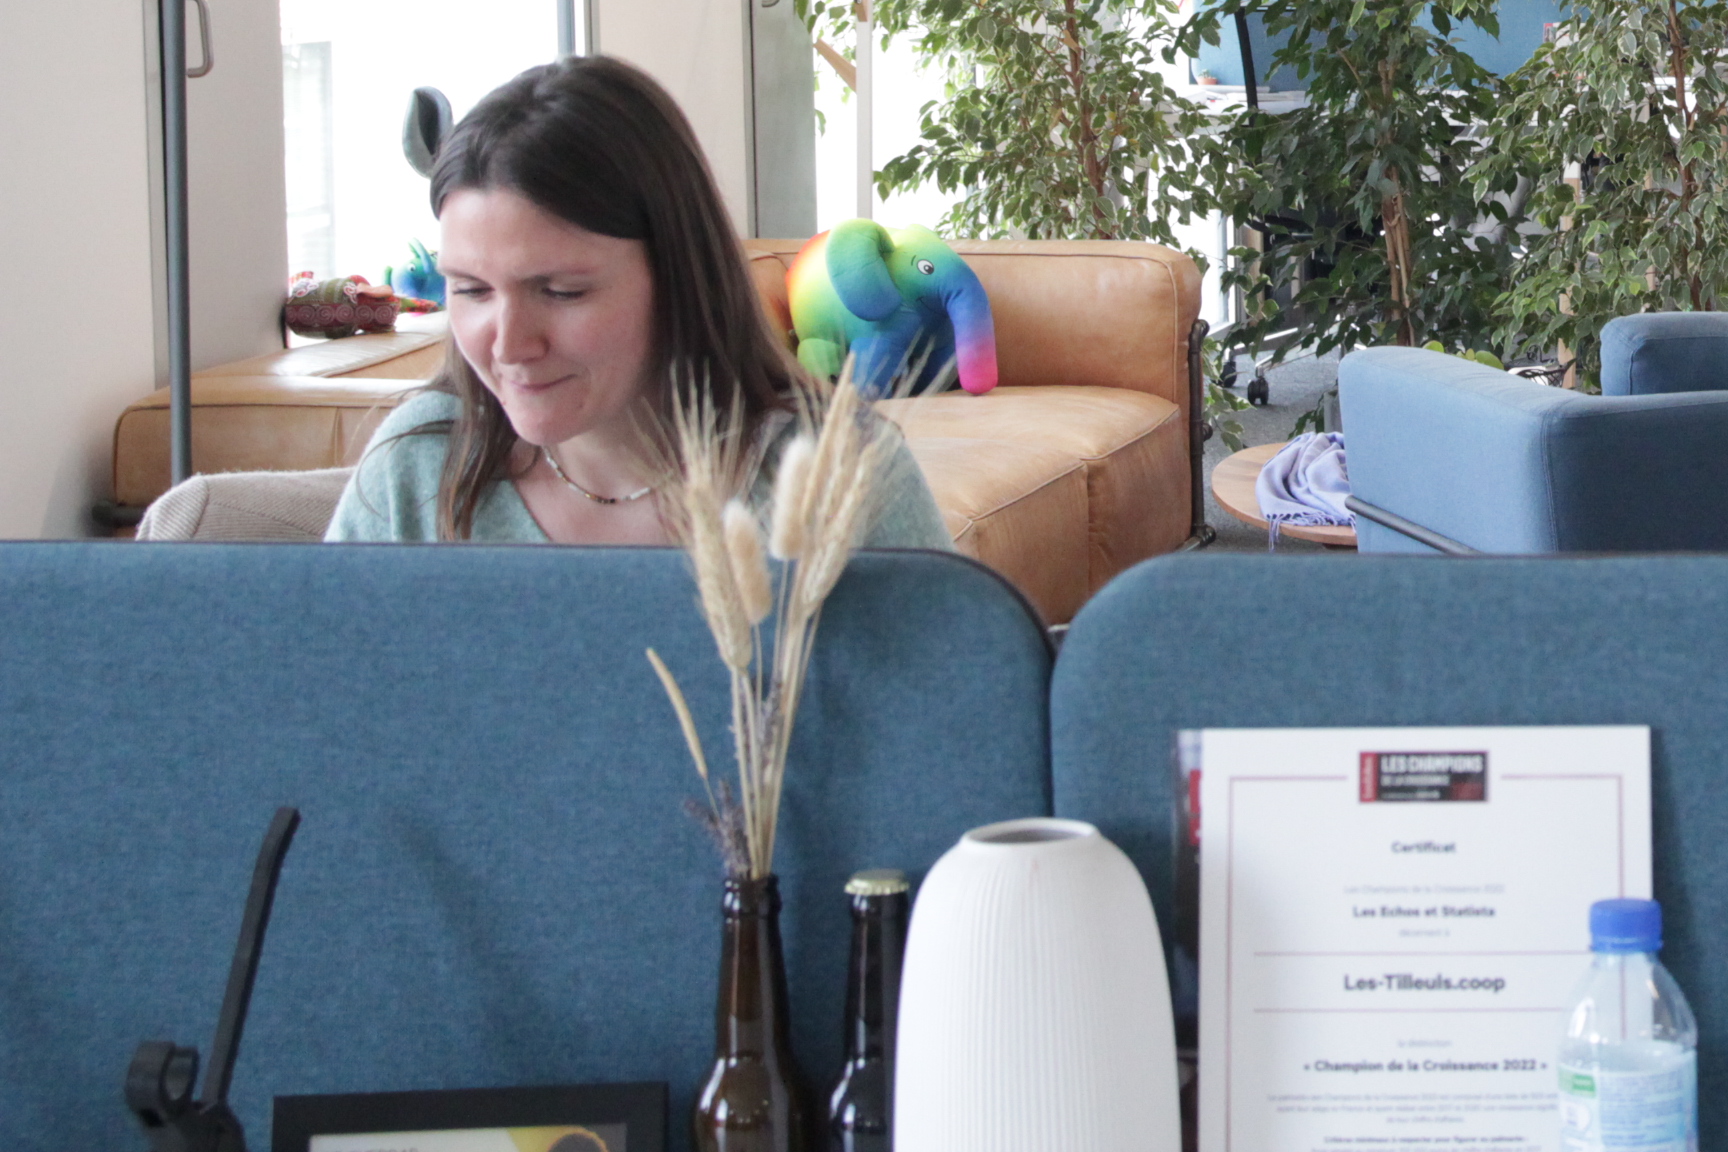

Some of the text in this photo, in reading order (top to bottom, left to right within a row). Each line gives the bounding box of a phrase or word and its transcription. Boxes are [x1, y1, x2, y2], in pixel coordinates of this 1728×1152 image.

[1391, 840, 1456, 854] Certificat
[1353, 905, 1496, 918] Les Echos et Statista
[1344, 973, 1505, 994] Les-Tilleuls.coop
[1314, 1059, 1384, 1073] Champion
[1387, 1059, 1403, 1072] de
[1407, 1059, 1419, 1072] la
[1423, 1059, 1498, 1072] Croissance
[1502, 1058, 1538, 1071] 2022
